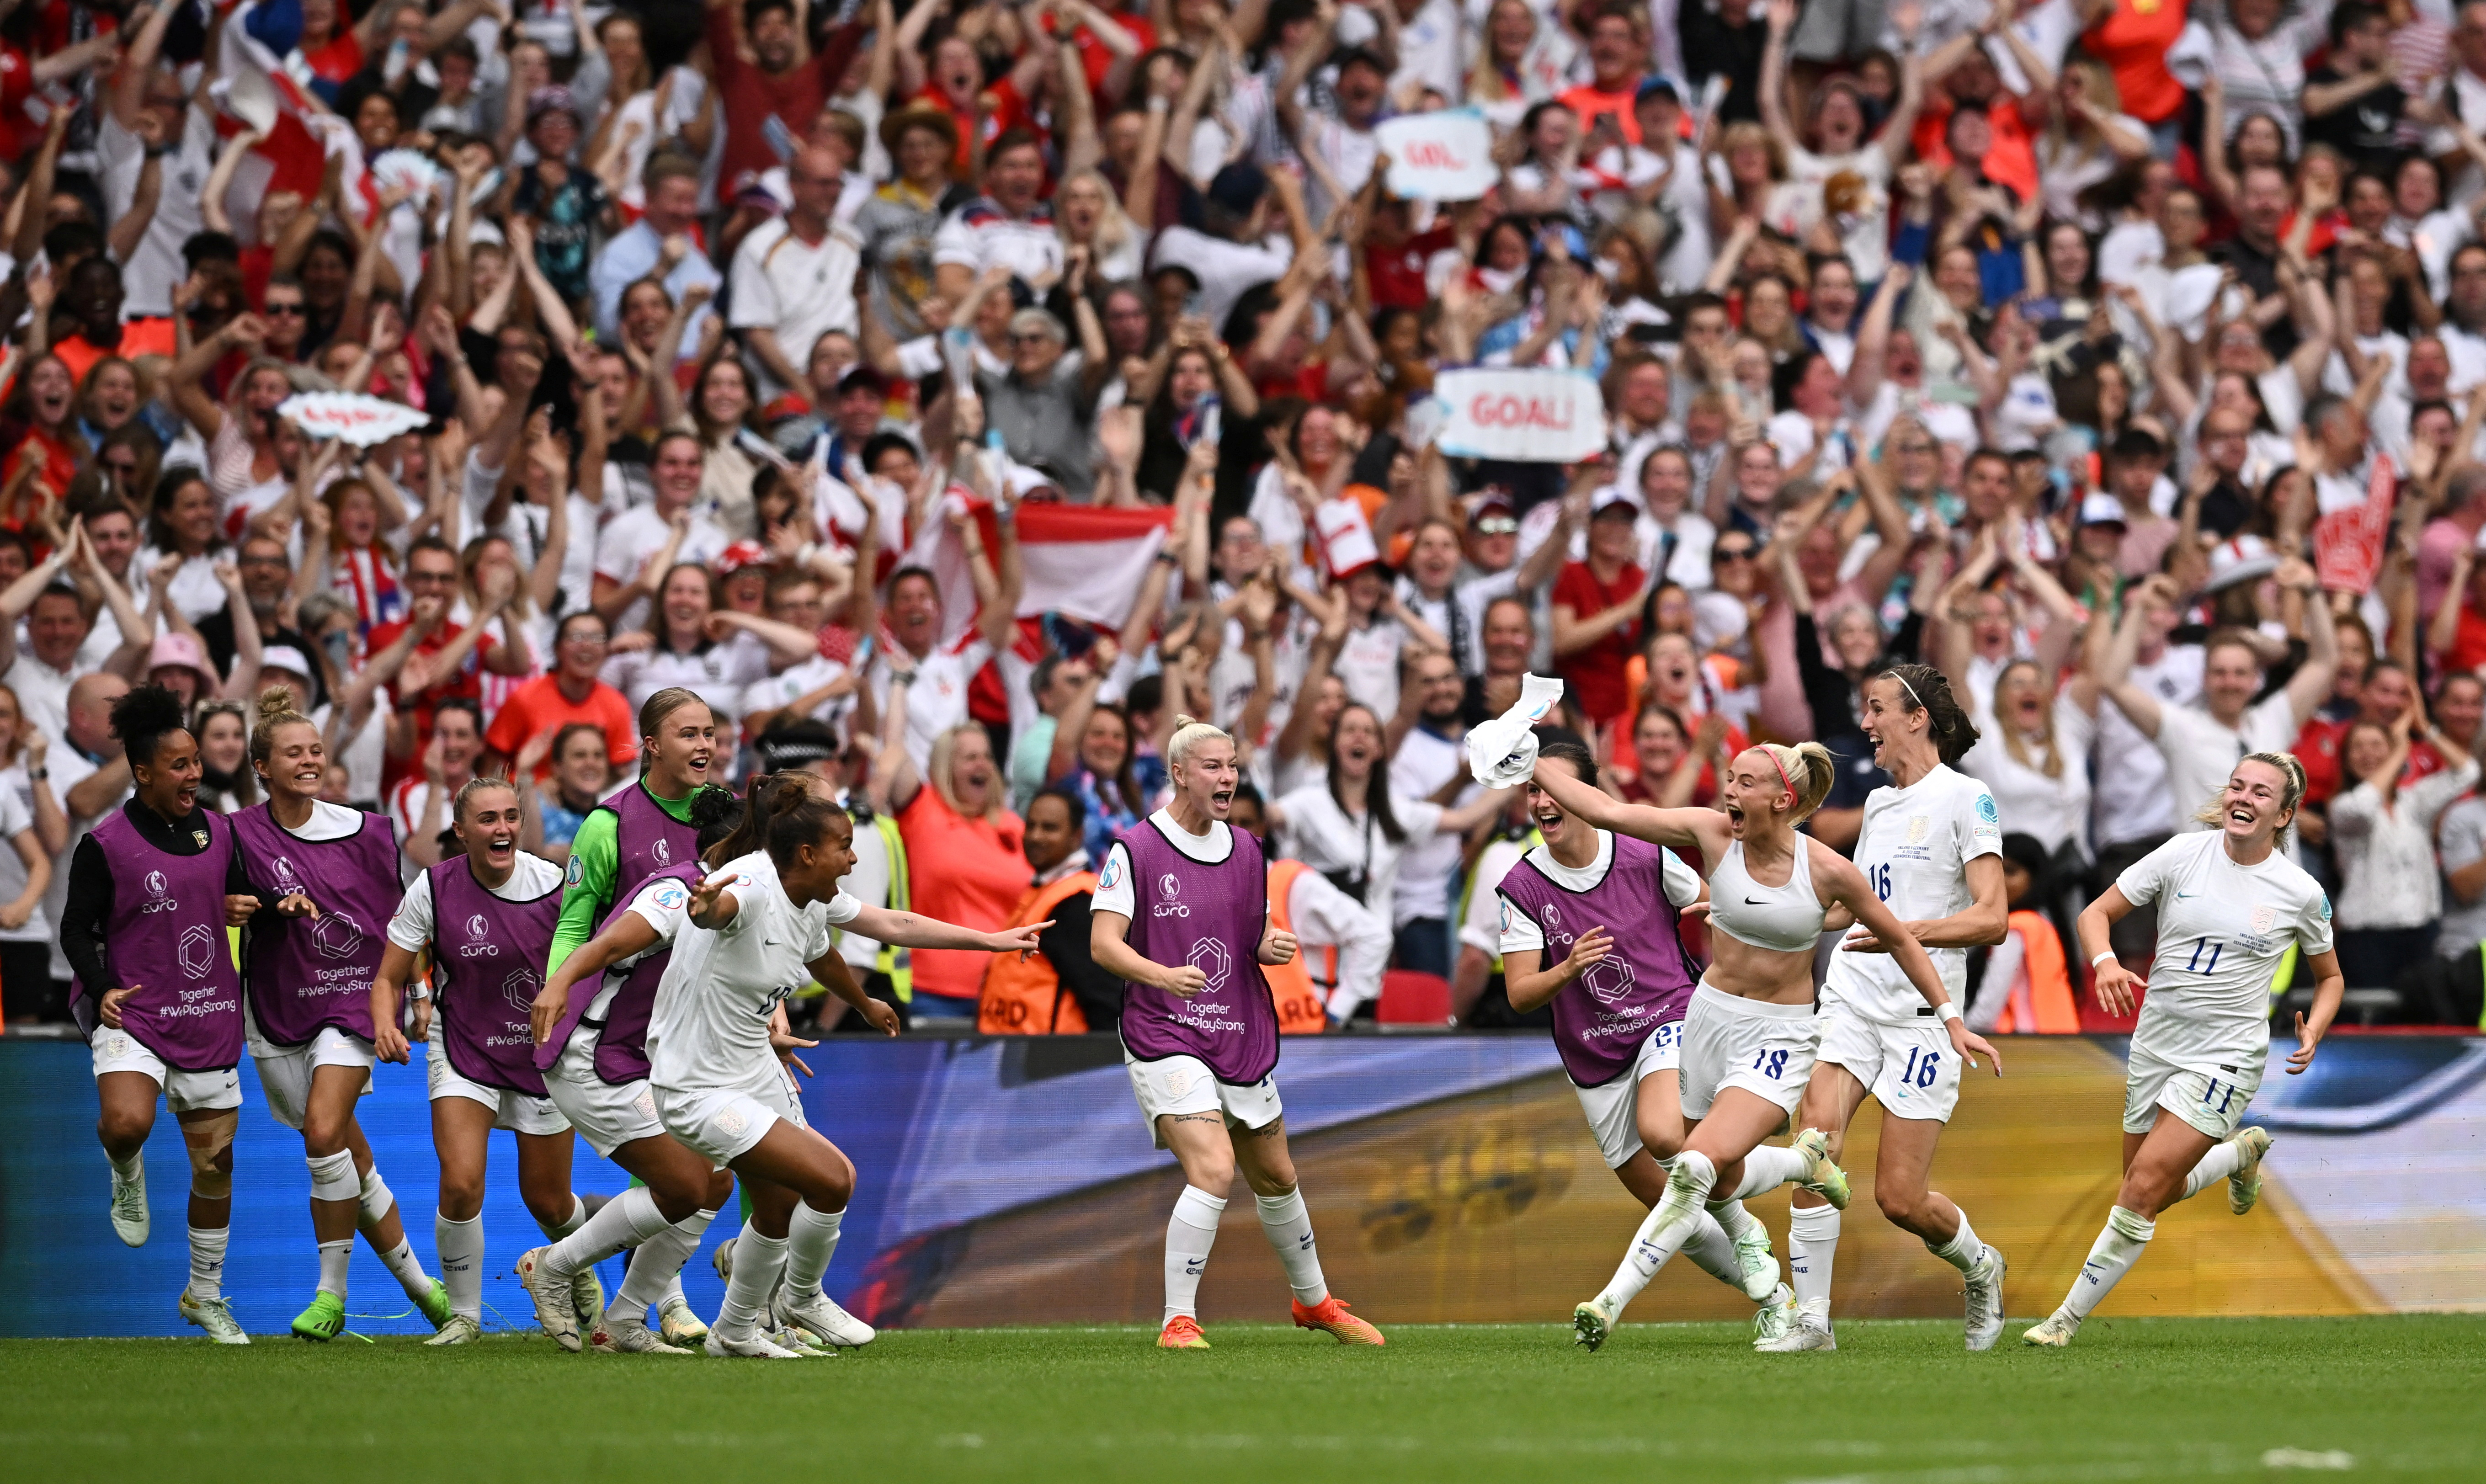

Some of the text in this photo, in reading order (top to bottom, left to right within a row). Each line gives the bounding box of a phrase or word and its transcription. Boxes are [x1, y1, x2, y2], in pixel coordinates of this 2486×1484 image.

[1868, 862, 1891, 902] 16
[2239, 933, 2255, 941] ENGLAND
[2186, 937, 2223, 976] 11
[314, 965, 371, 981] Together
[178, 985, 217, 1003] Together
[160, 1000, 237, 1017] #WePlayStrong
[1184, 1000, 1230, 1016] Together
[1595, 1004, 1645, 1022] Together
[1168, 1013, 1245, 1035] #WePlayStrong
[1753, 1048, 1789, 1080] 18
[1900, 1046, 1941, 1089] 16
[2204, 1077, 2235, 1114] 11
